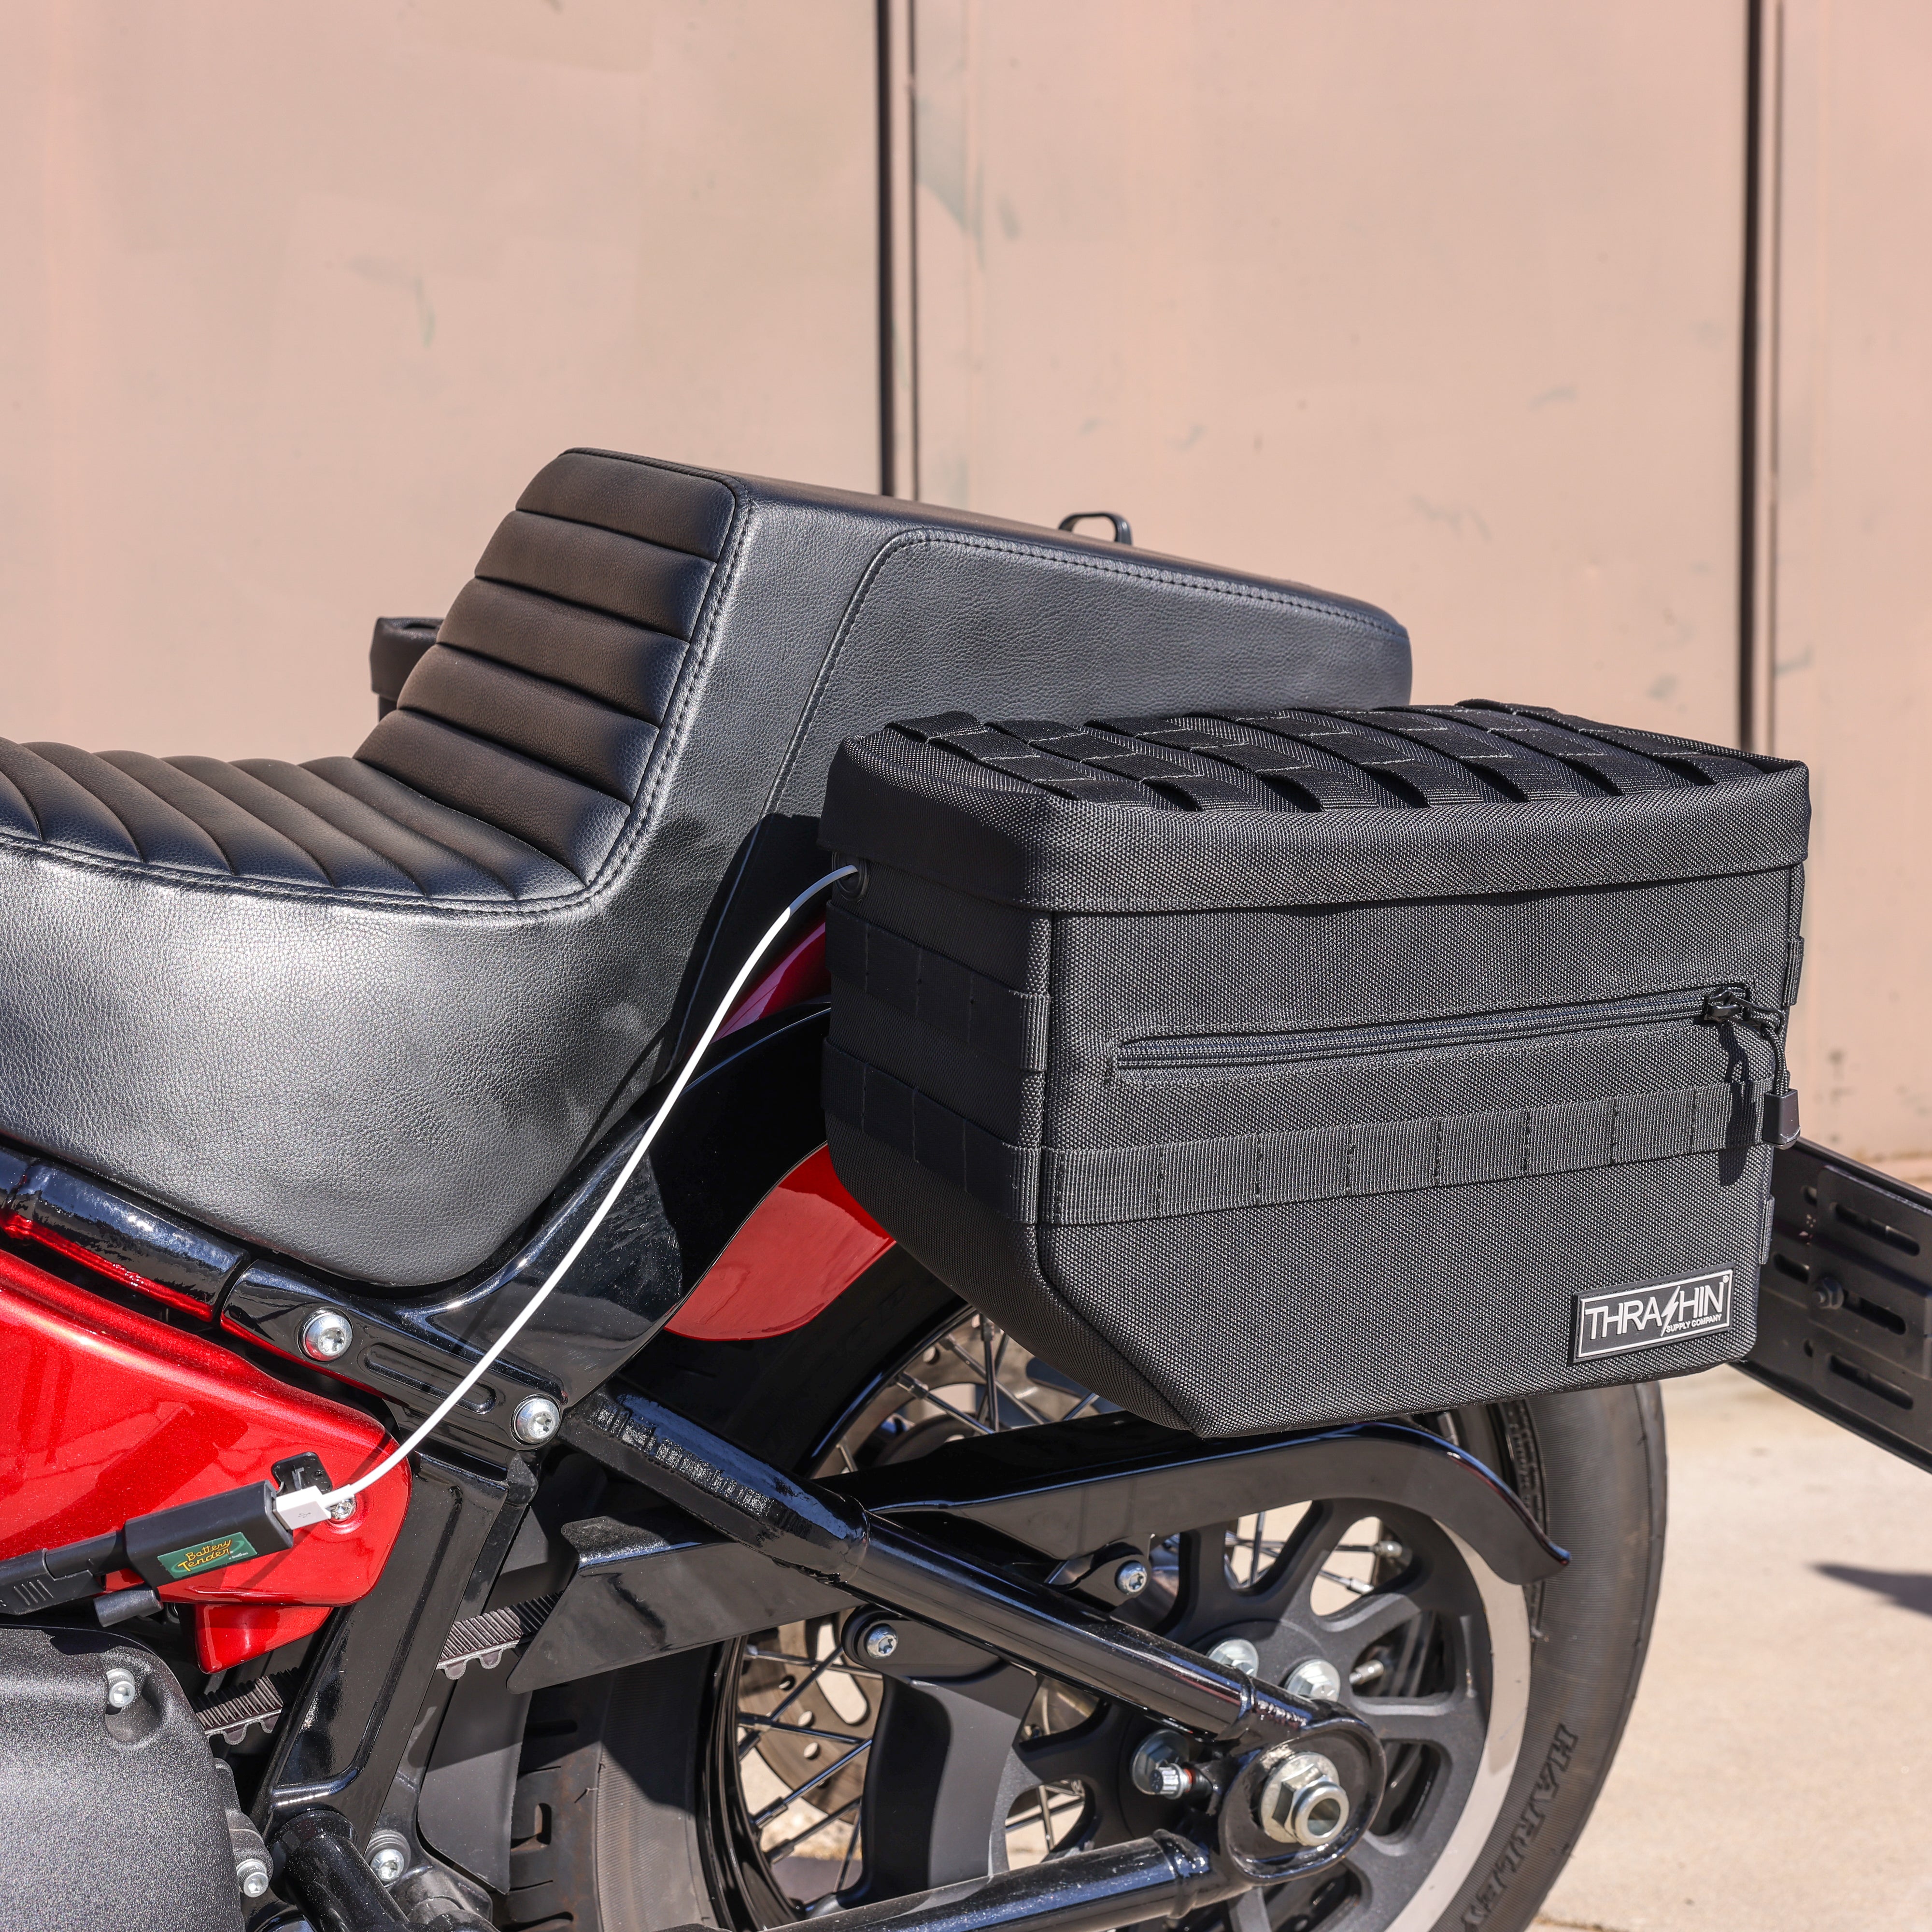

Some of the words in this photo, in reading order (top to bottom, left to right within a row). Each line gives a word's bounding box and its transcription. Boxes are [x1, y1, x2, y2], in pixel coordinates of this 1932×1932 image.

[1665, 1321, 1690, 1333] SUPPLY
[1691, 1313, 1722, 1327] COMPANY
[177, 1548, 230, 1572] Tender
[185, 1539, 232, 1562] Battery
